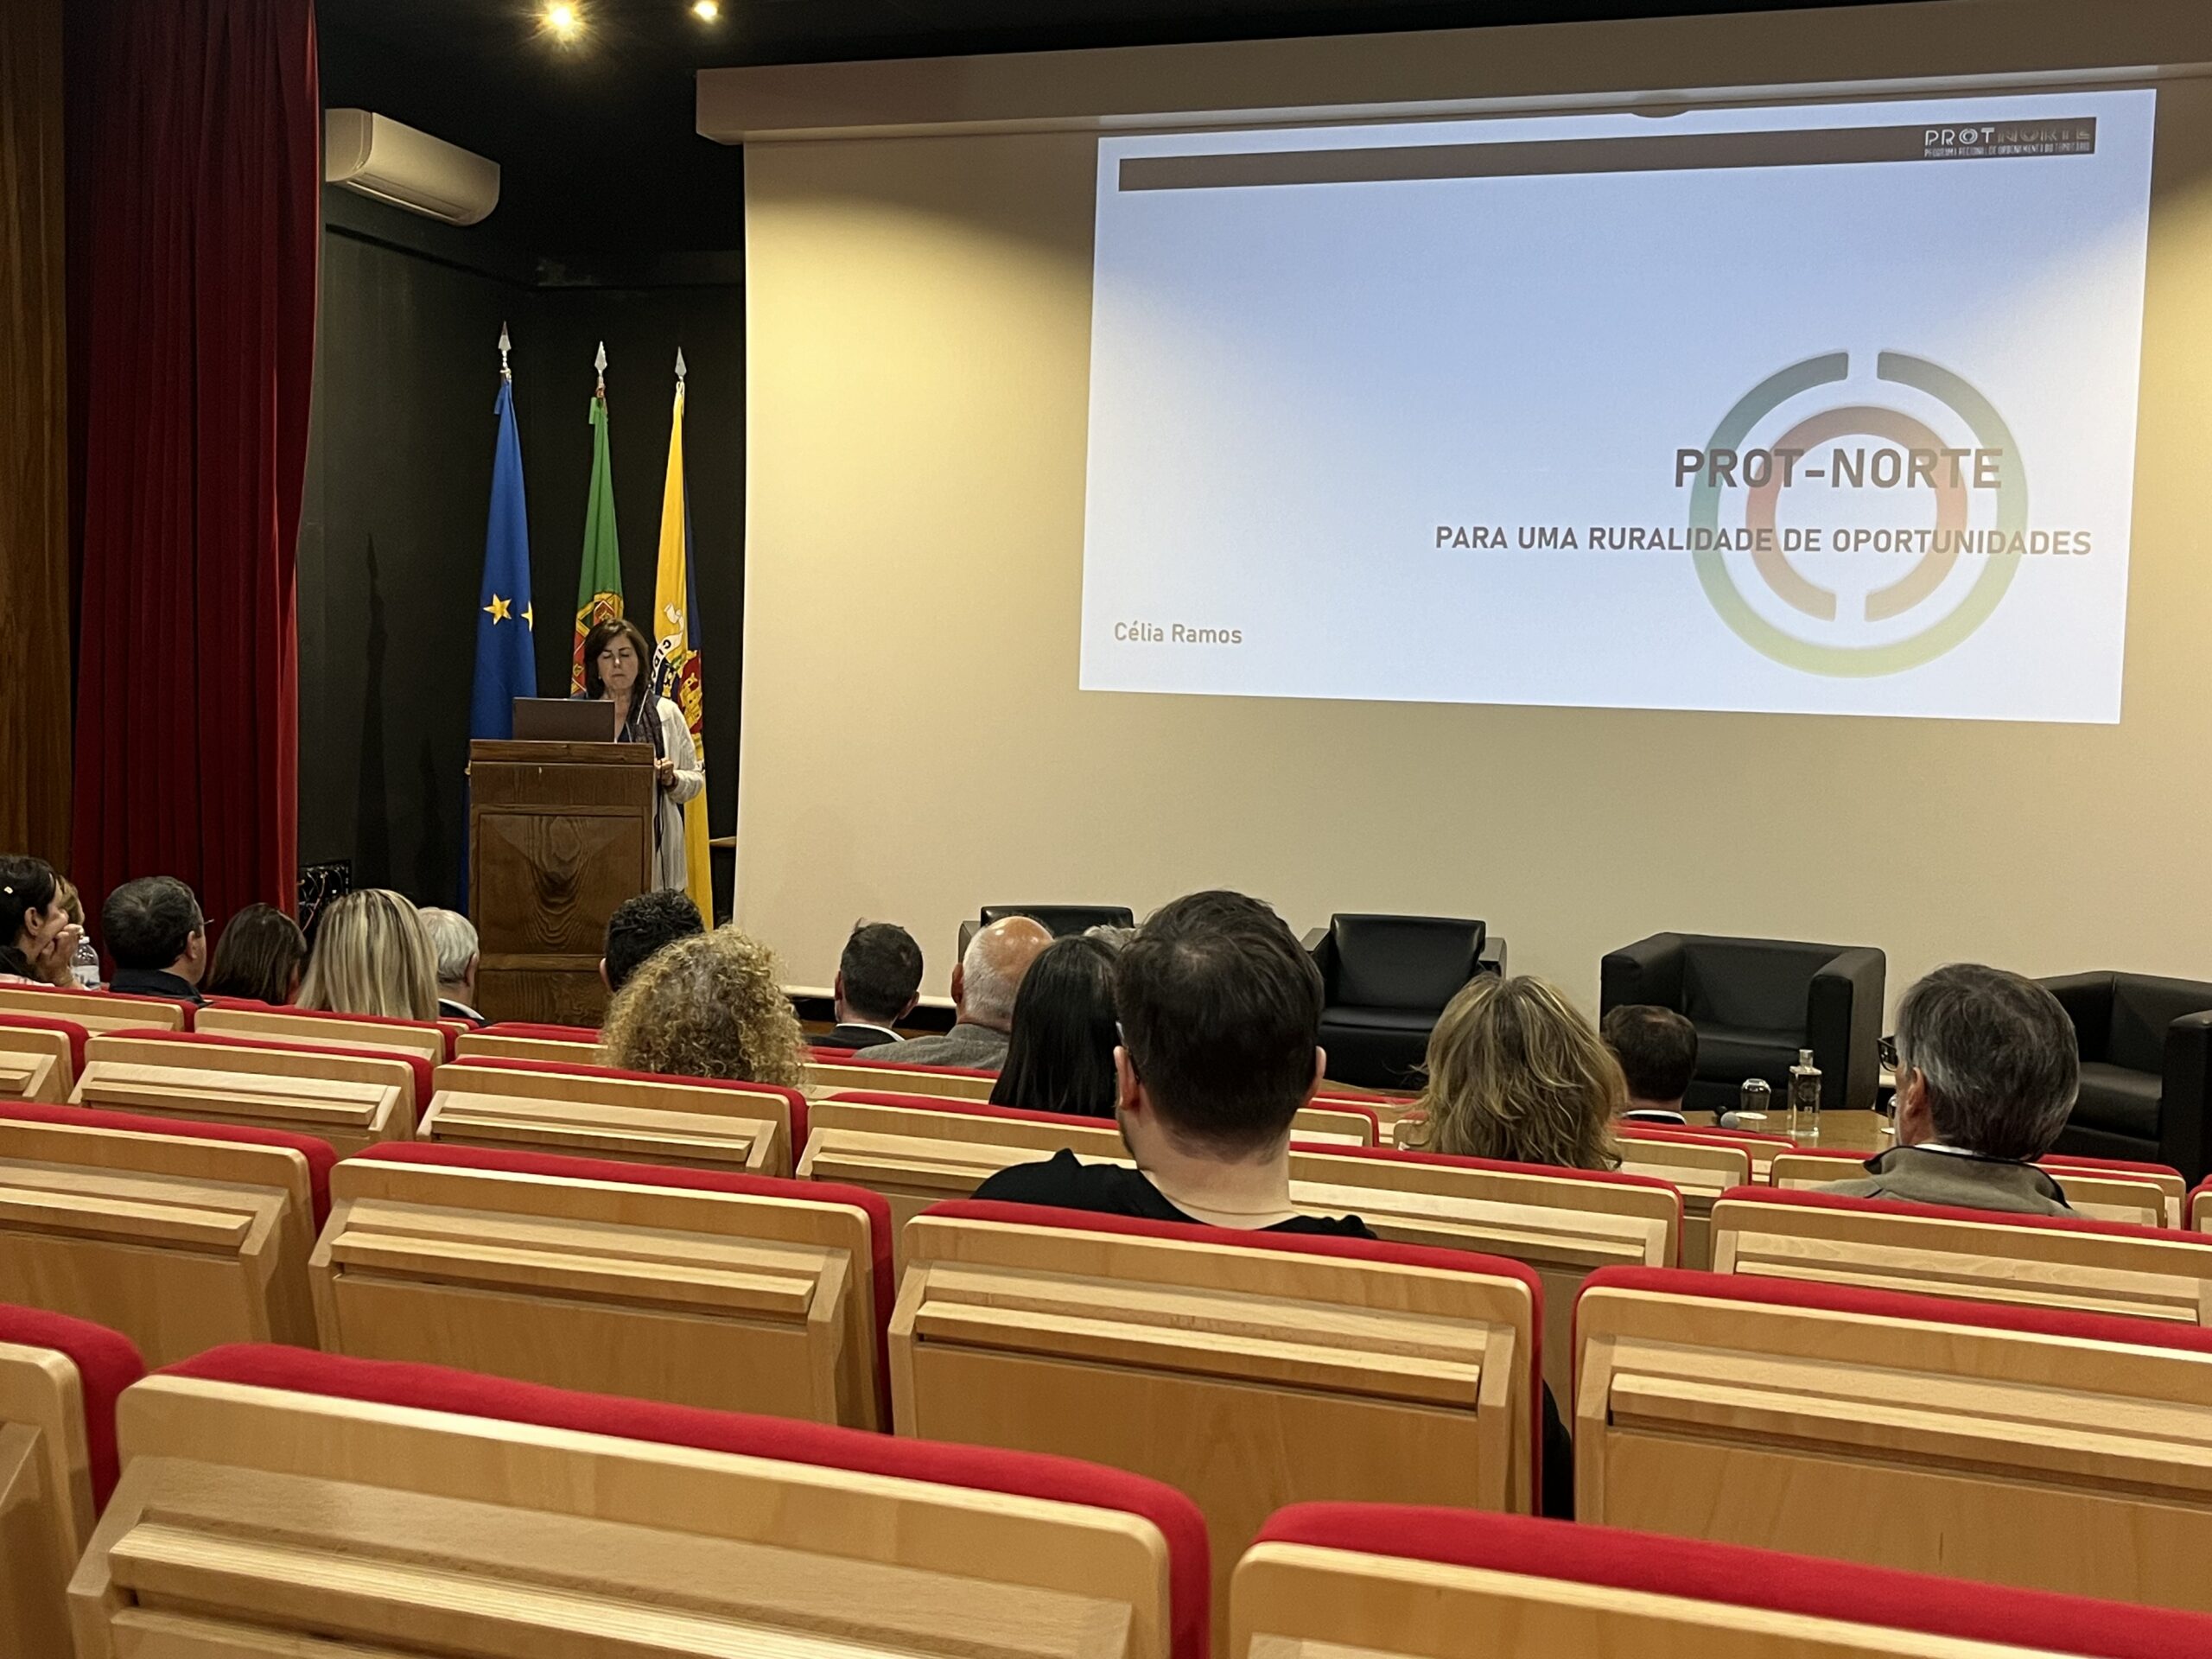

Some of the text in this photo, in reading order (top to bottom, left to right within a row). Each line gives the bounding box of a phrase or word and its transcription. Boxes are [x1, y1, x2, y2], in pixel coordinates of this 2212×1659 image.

[1924, 127, 1995, 146] PROT
[1675, 448, 2004, 489] PROT-NORTE
[1435, 525, 2092, 556] PARA UMA RURALIDADE DE OPORTUNIDADES
[1114, 620, 1243, 645] Célia Ramos
